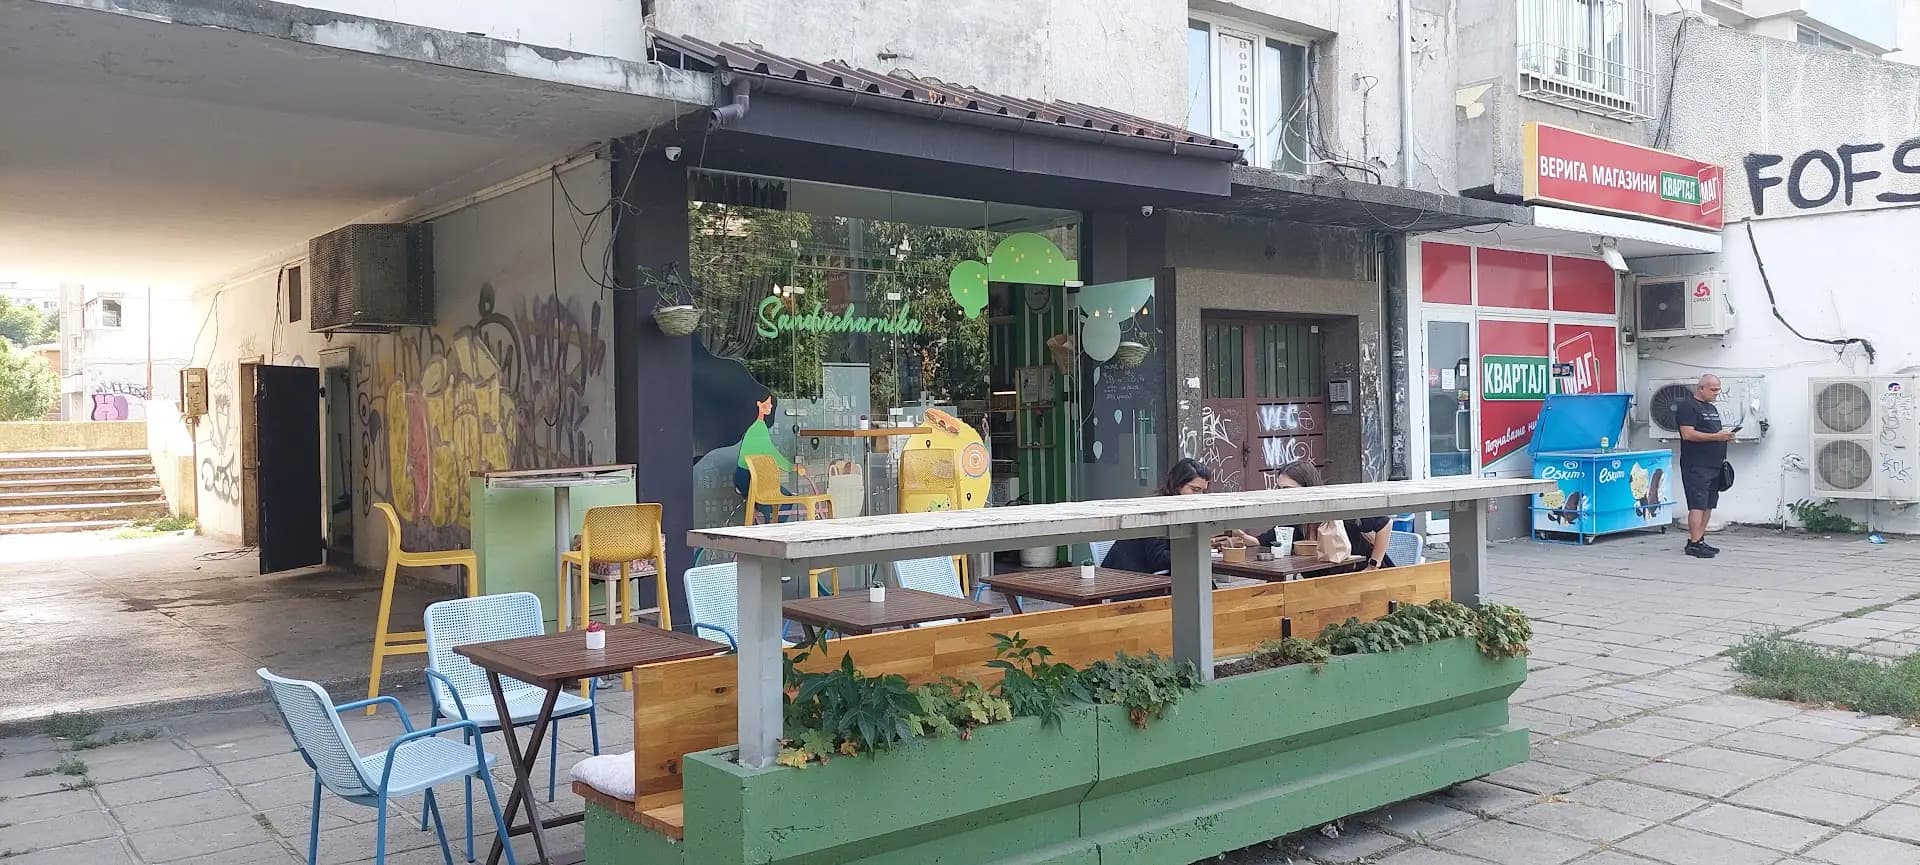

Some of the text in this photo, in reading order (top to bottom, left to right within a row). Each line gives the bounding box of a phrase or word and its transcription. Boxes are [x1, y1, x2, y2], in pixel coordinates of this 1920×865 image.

[1238, 40, 1250, 137] ВОРОШИЛОВ
[1540, 155, 1718, 201] ВЕРИГА МАГАЗИНИ КВАРТАЛ МАГ
[757, 295, 923, 339] Sandvicharnika
[1484, 362, 1547, 395] КВАРТАЛ
